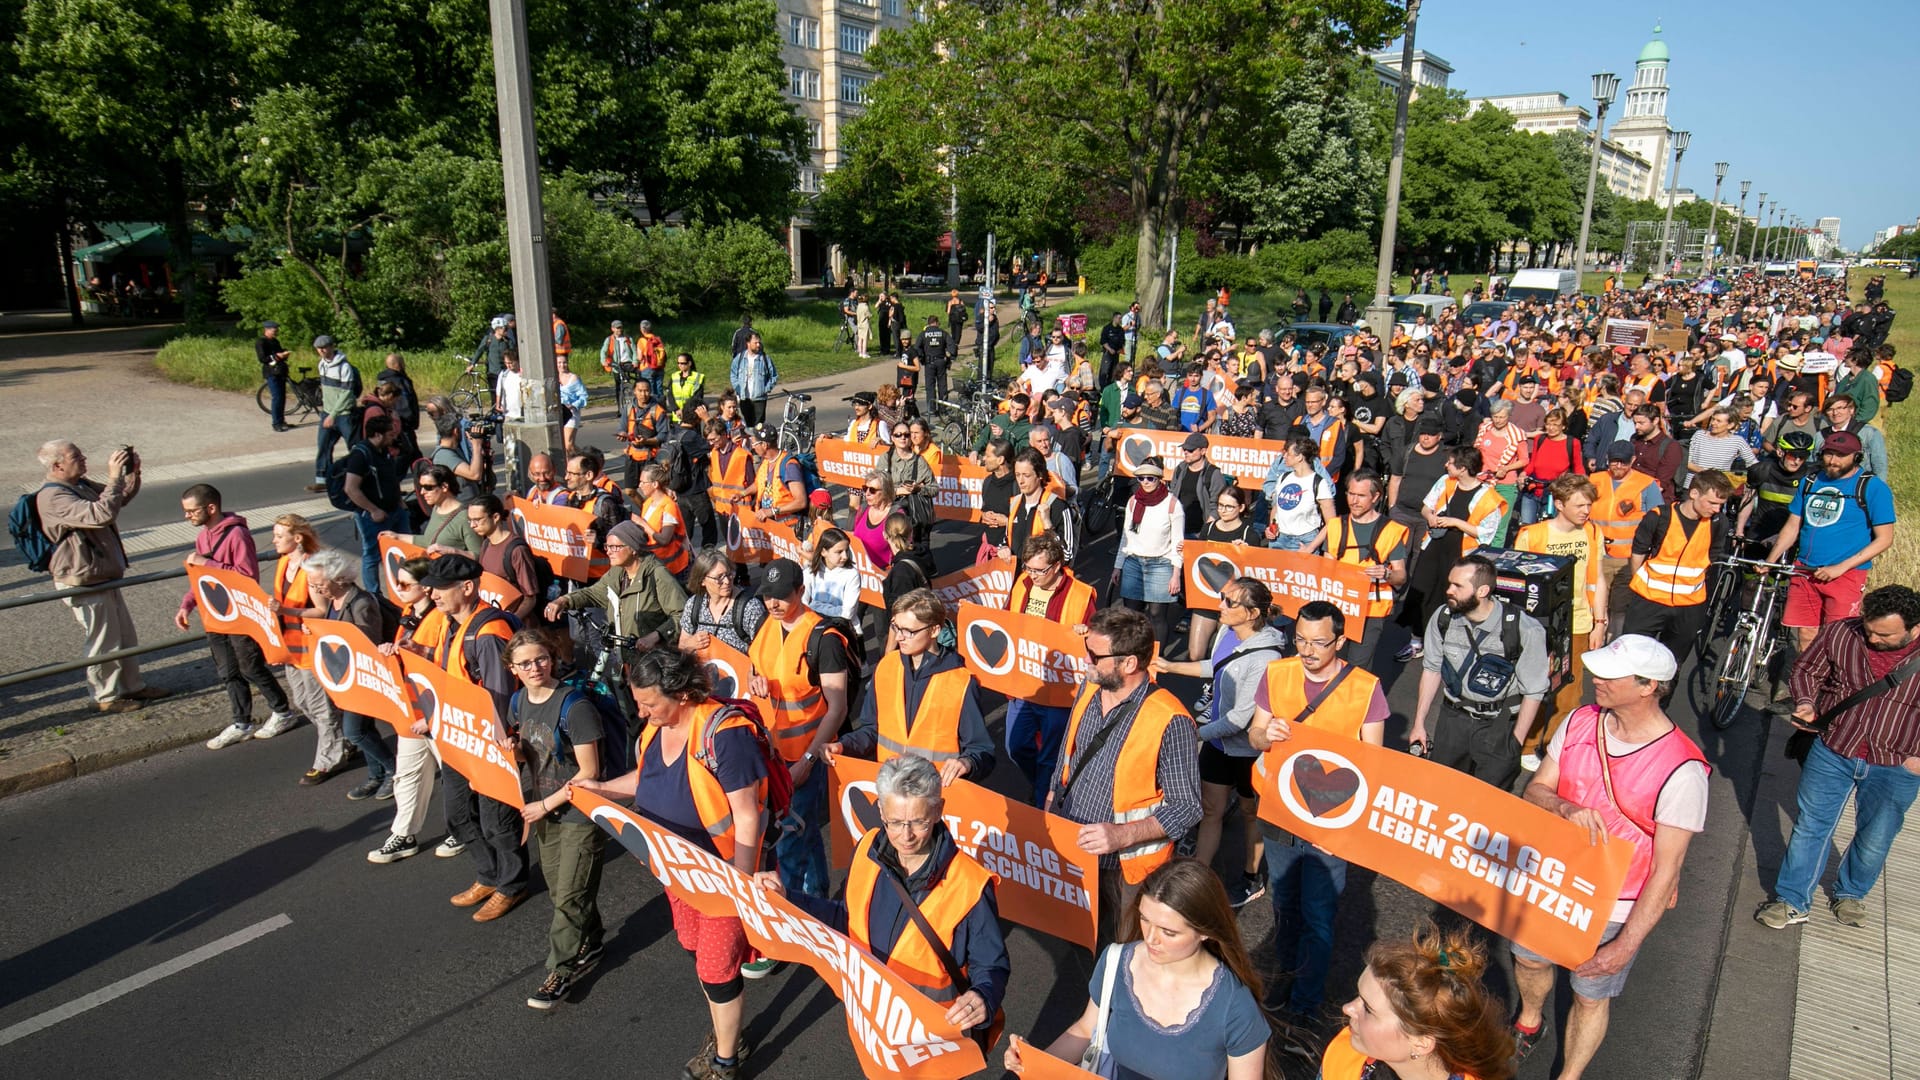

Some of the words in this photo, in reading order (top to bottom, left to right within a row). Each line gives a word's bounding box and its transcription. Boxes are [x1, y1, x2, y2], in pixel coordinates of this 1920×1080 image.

[842, 450, 872, 466] MEHR
[1279, 491, 1300, 501] NASA
[1546, 542, 1573, 551] STOPPT
[1243, 565, 1281, 583] ART.
[1284, 569, 1318, 589] 20A
[1321, 576, 1344, 599] GG
[356, 651, 377, 675] ART.
[1018, 638, 1050, 666] ART.
[357, 670, 382, 694] LEBEN
[1019, 656, 1059, 683] LEBEN
[442, 702, 478, 735] ART.
[443, 723, 485, 759] LEBEN
[970, 821, 1021, 860] 20A
[1025, 841, 1062, 876] GG
[1066, 864, 1085, 879] =
[1372, 785, 1438, 832] ART.
[1447, 813, 1512, 859] 20A
[1515, 845, 1567, 889] GG
[1571, 875, 1597, 897] =
[652, 831, 751, 902] LETZTE
[983, 850, 1092, 912] SCHÜTZEN
[1367, 810, 1448, 860] LEBEN
[1449, 845, 1594, 933] SCHÜTZEN
